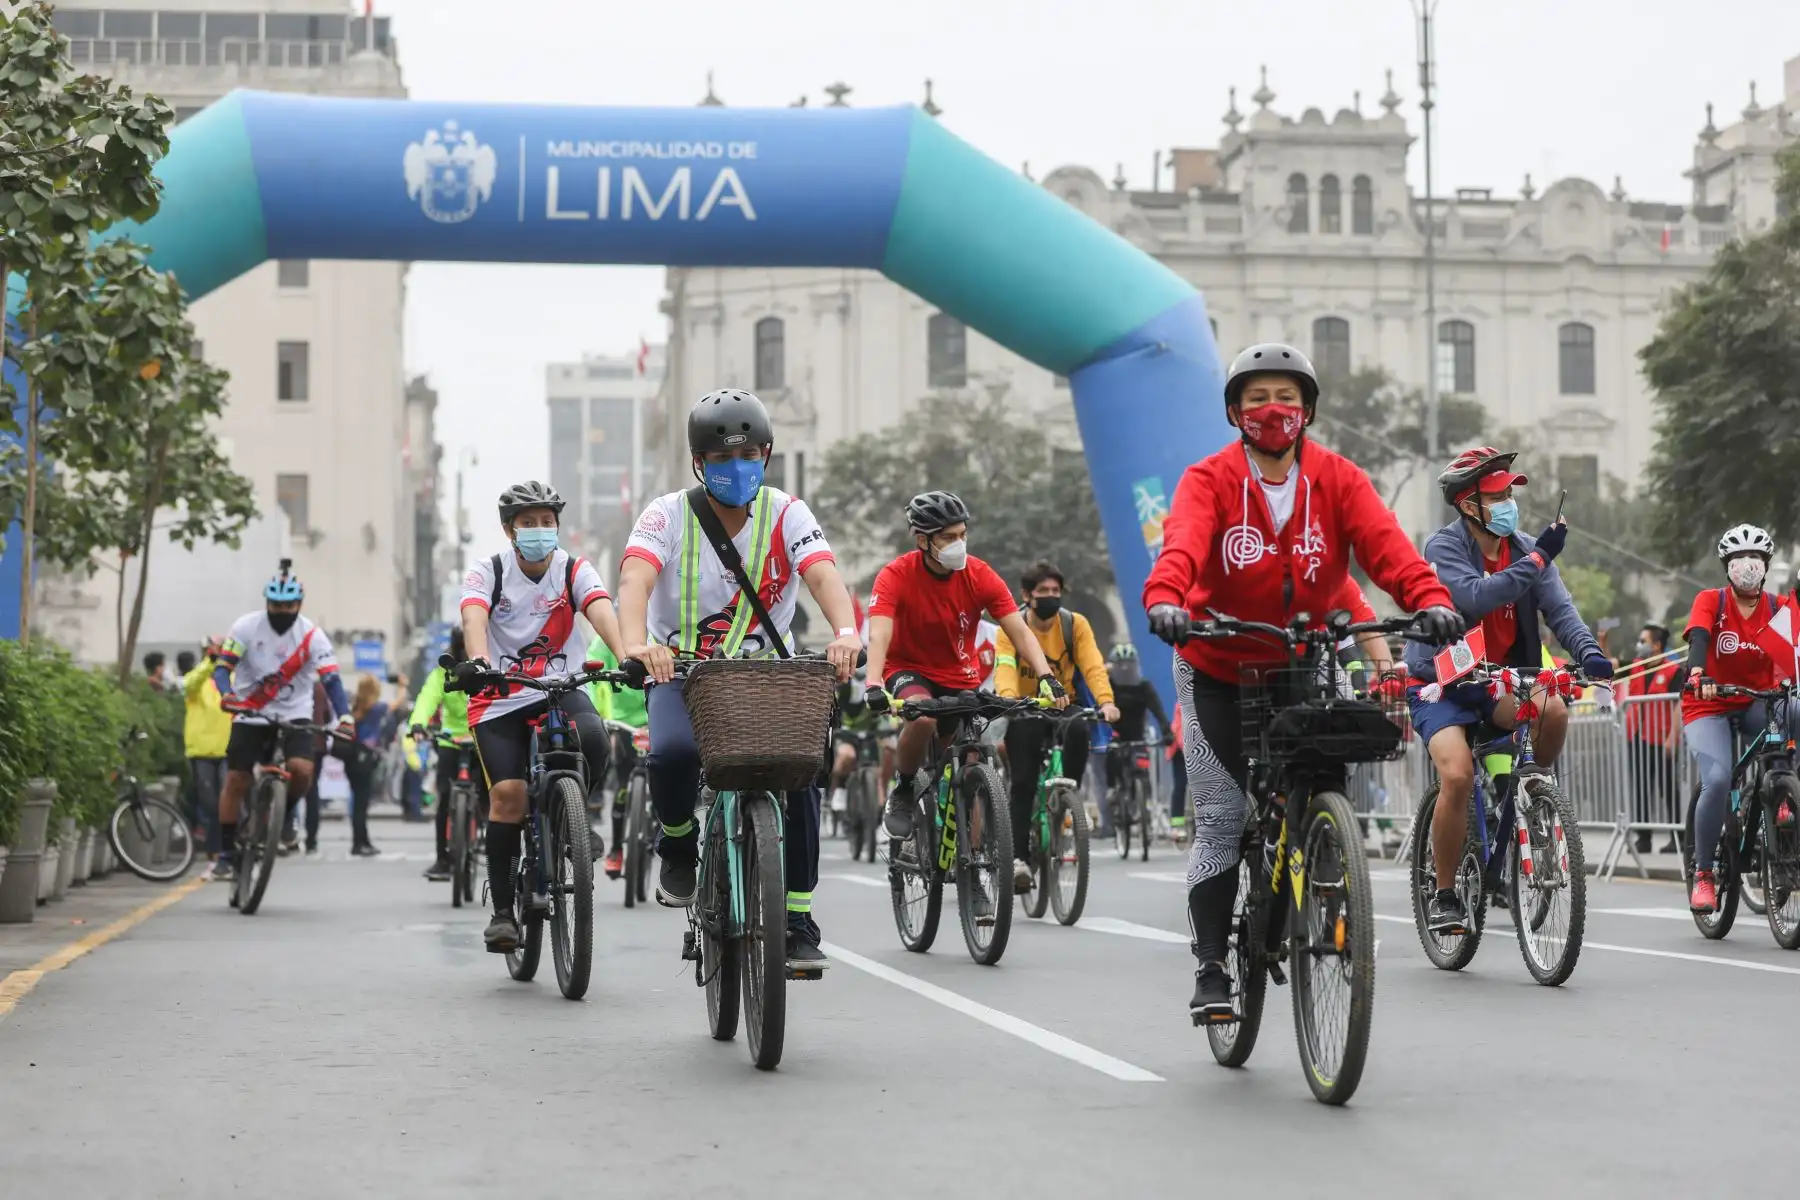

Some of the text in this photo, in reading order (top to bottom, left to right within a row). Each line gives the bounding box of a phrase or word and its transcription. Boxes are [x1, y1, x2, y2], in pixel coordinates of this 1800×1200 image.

[547, 140, 758, 159] MUNICIPALIDAD DE
[546, 165, 758, 221] LIMA
[791, 529, 824, 553] PER
[939, 788, 957, 872] SCO
